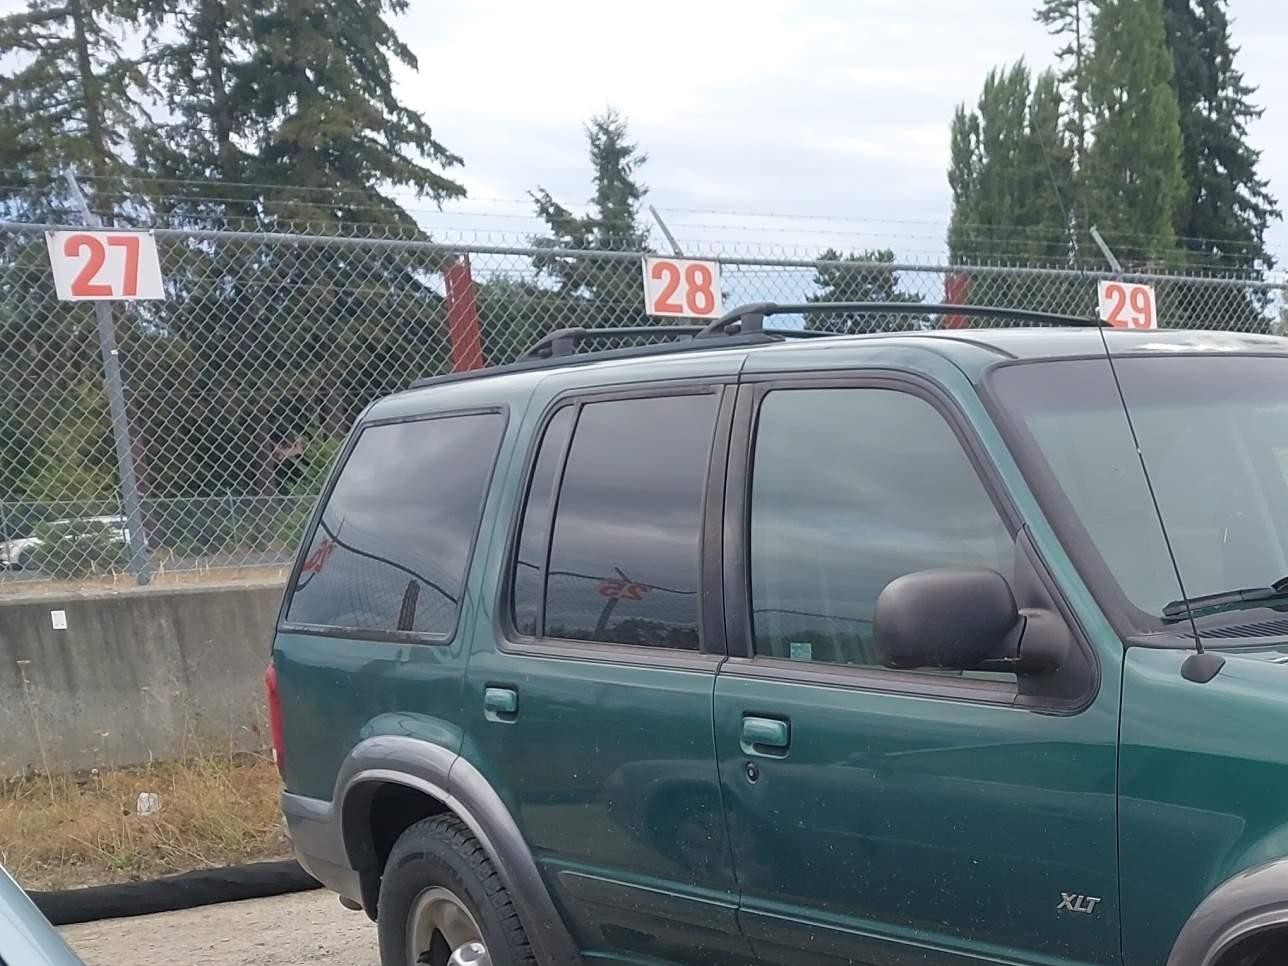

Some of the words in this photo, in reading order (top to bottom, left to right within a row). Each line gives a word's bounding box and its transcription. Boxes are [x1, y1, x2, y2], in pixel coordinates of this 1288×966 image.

[64, 234, 140, 297] 27
[652, 261, 714, 315] 28
[1105, 284, 1152, 329] 29
[1056, 892, 1102, 914] XLT
